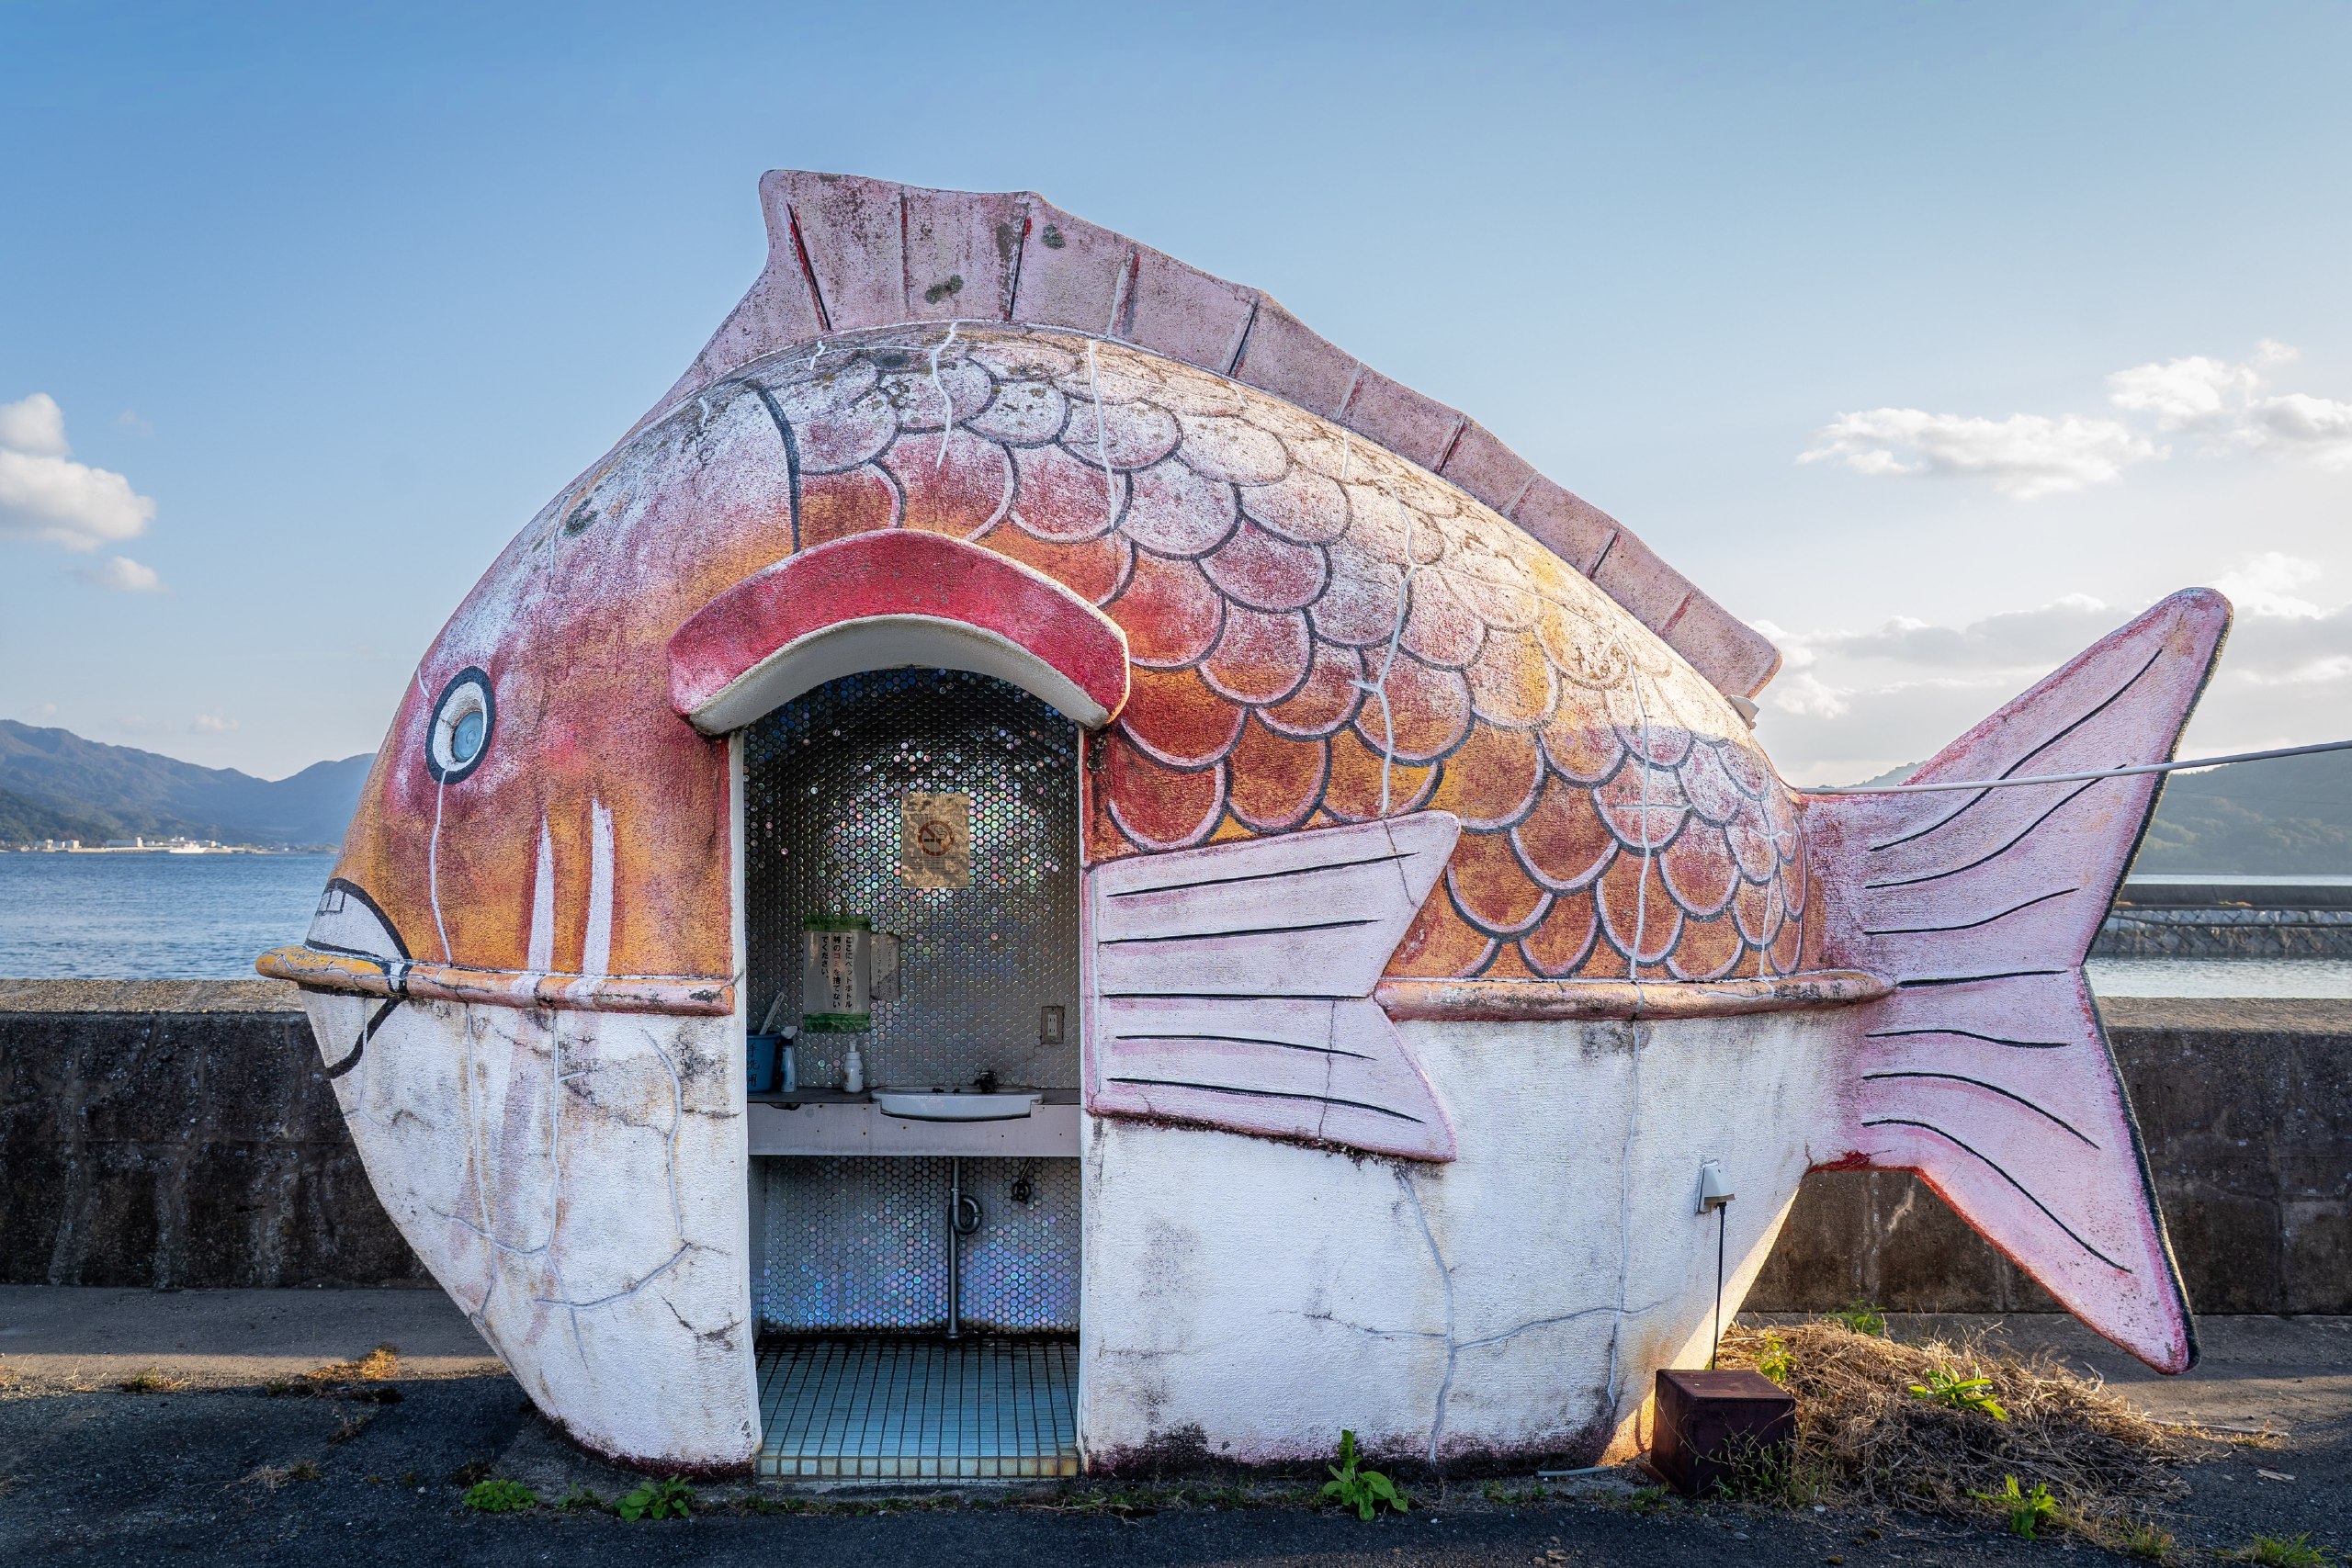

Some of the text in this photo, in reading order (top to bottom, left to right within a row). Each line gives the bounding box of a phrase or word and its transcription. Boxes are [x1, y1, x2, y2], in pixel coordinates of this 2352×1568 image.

[820, 936, 830, 979] でください。
[832, 935, 841, 1009] 等のゴミを捨てない
[844, 936, 853, 1009] ここにペットボトル
[747, 1042, 761, 1088] 手洗用
